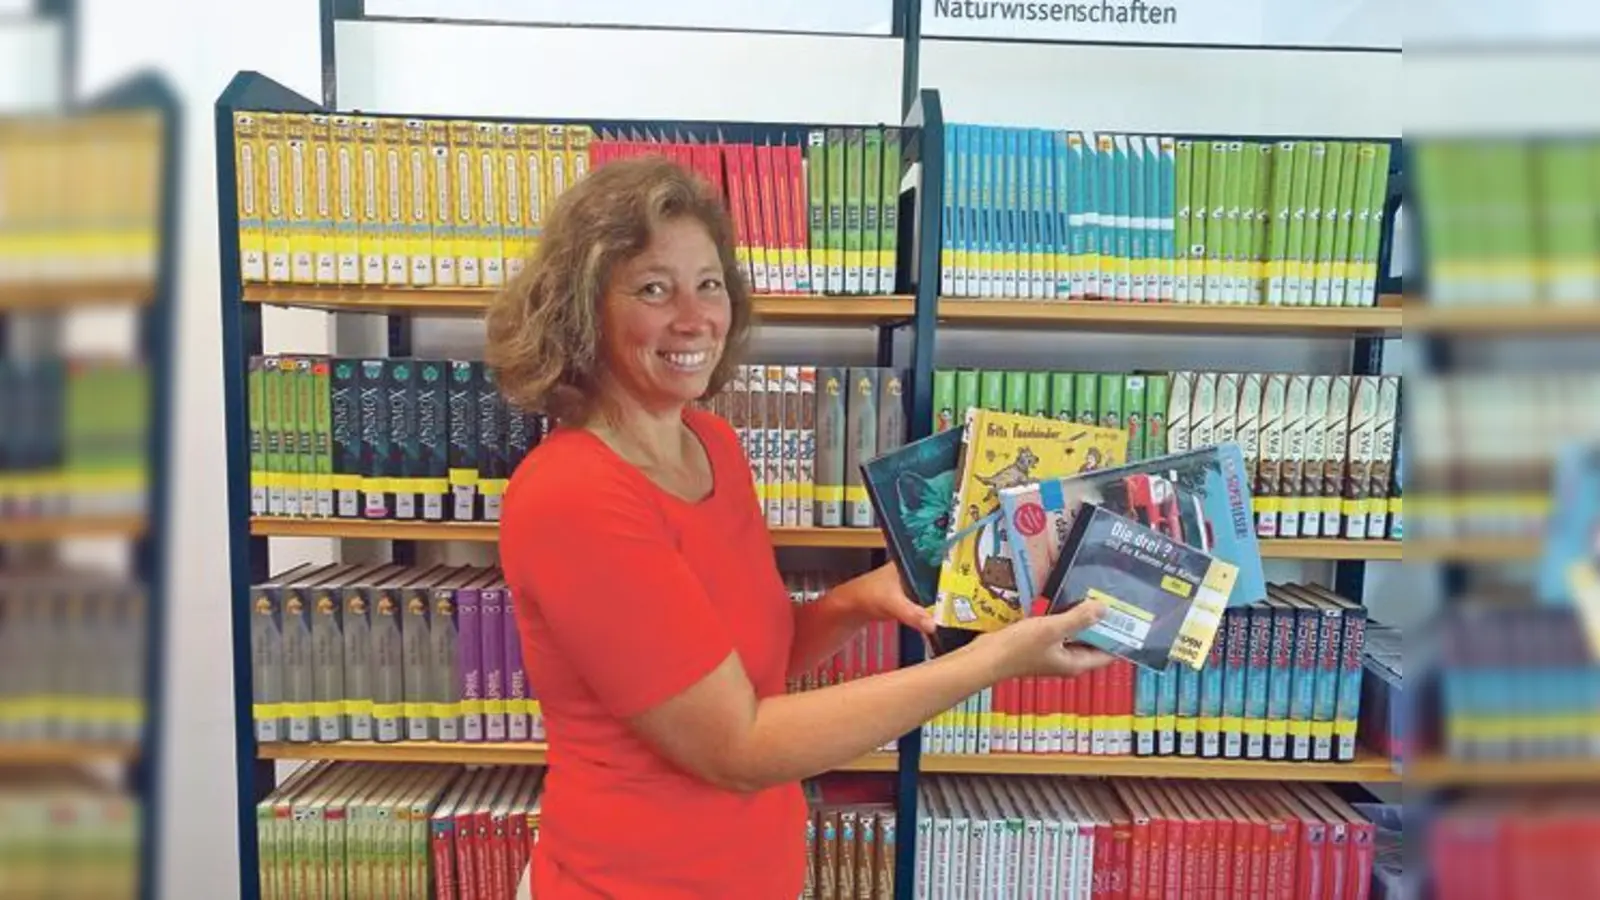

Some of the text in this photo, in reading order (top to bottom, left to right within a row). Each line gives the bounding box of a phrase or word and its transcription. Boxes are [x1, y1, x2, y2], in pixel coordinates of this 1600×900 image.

[934, 0, 1177, 24] Naturwissenschaften
[1268, 429, 1280, 454] PAX
[1291, 430, 1302, 454] PAX
[1334, 430, 1345, 453] PAX
[1360, 431, 1372, 455] PAX
[1381, 431, 1392, 455] PAX
[1110, 521, 1133, 542] Die
[1135, 532, 1161, 554] drei
